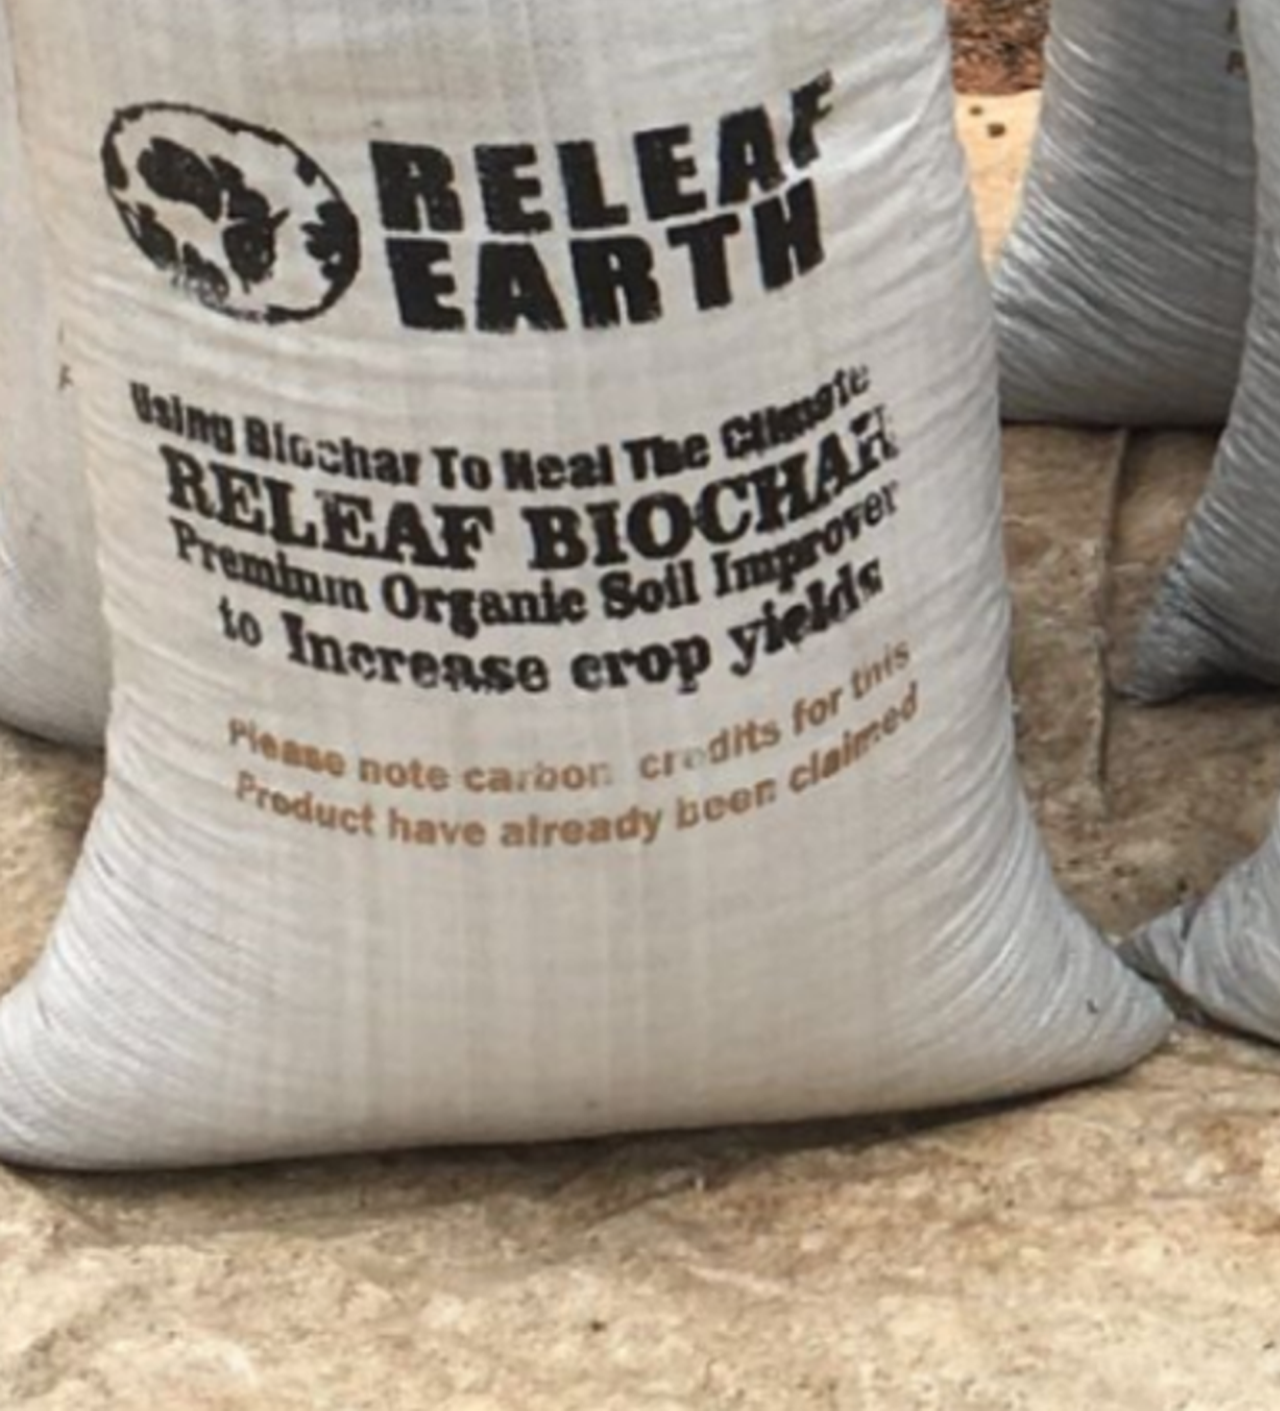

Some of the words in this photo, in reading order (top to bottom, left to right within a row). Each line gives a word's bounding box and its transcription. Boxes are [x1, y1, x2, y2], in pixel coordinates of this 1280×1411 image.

[369, 69, 834, 235] RELEAF
[384, 177, 824, 333] EARTH
[130, 381, 235, 455] Using
[243, 415, 420, 487] Biochar
[432, 446, 492, 489] To
[501, 445, 615, 491] Heal
[622, 433, 710, 480] The
[720, 364, 870, 459] Climate
[159, 444, 494, 569] RELEAF
[520, 404, 898, 571] BIOCHAR
[169, 515, 370, 613] Premium
[381, 573, 588, 639] Organic
[599, 560, 699, 619] Soil
[711, 482, 898, 597] Improver
[217, 595, 262, 647] to
[280, 611, 550, 694] Increase
[571, 634, 711, 694] crop
[727, 557, 884, 677] yields
[228, 717, 346, 777] Please
[358, 759, 449, 791] note
[463, 761, 612, 793] carbon
[792, 686, 843, 735] for
[236, 769, 375, 836] Product
[387, 815, 487, 847] have
[500, 805, 664, 849] already
[675, 776, 777, 831] been
[788, 679, 919, 794] claimed
